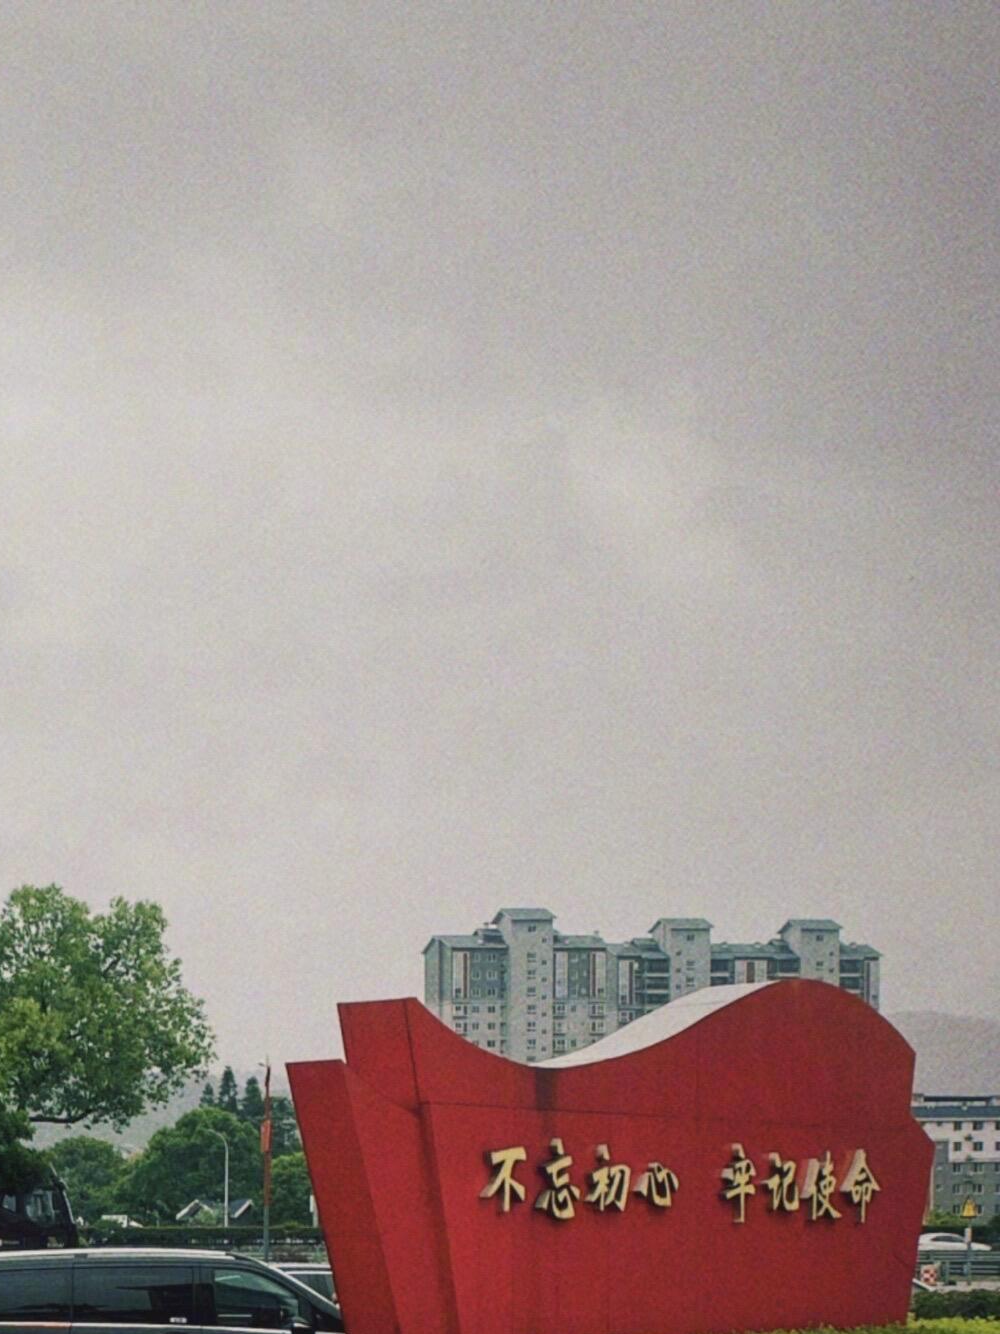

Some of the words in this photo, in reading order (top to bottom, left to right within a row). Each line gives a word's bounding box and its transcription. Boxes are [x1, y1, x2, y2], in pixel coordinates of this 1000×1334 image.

[480, 1138, 679, 1220] 不忘初心
[721, 1143, 880, 1223] 牢记使命
